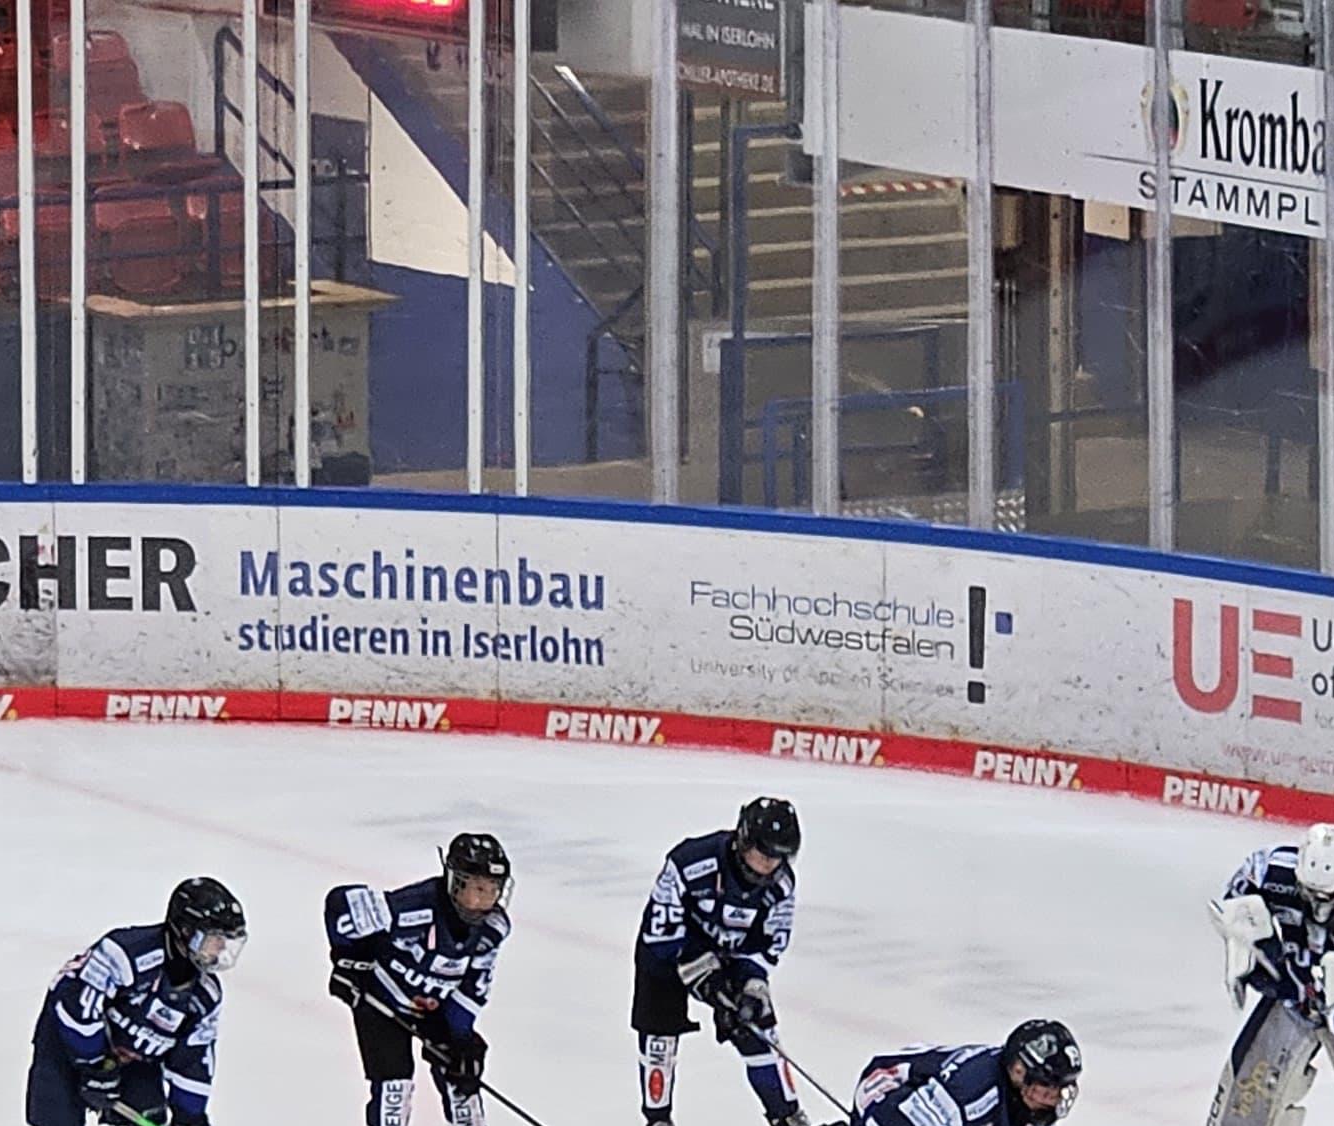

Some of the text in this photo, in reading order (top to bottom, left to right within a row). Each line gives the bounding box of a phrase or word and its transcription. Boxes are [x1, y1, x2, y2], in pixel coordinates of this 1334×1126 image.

[240, 549, 605, 611] Maschinenbau
[690, 581, 955, 628] Fachhochschule
[238, 614, 605, 667] studieren in Iserlohn
[729, 615, 955, 660] Südwestfalen
[1173, 597, 1302, 725] UE
